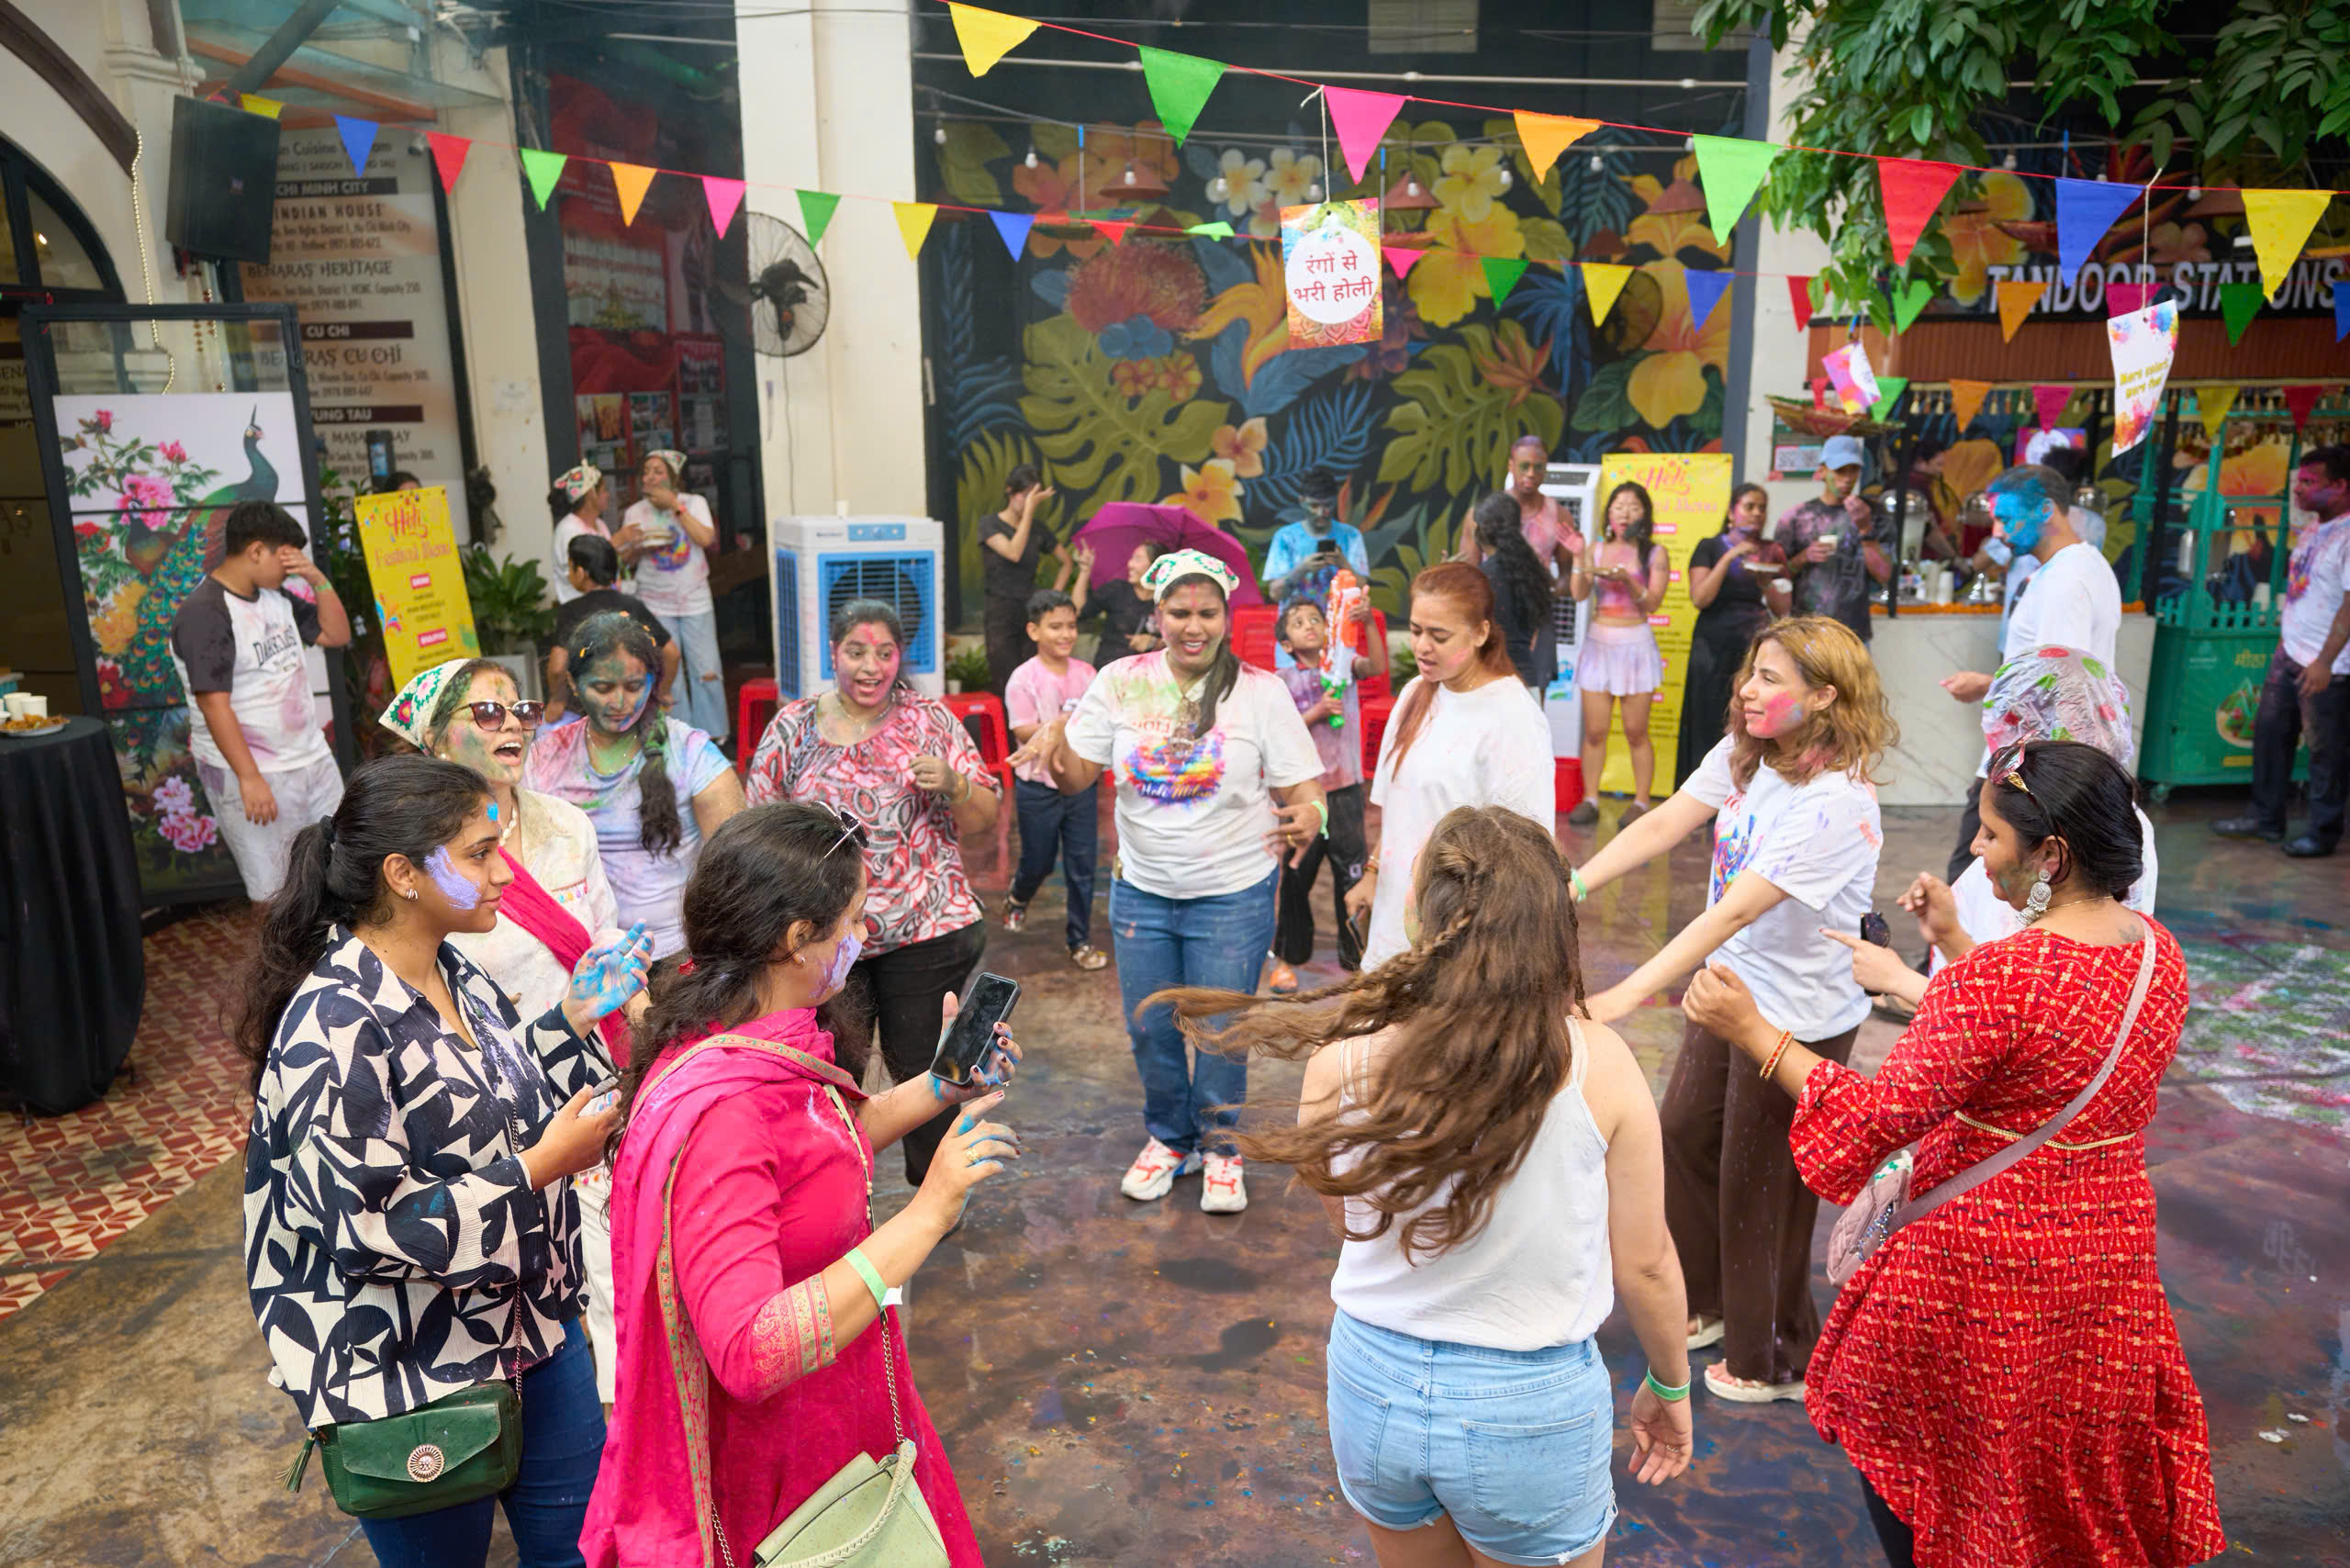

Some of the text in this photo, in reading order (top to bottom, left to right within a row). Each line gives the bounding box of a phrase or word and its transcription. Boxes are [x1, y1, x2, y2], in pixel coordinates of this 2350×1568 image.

[276, 182, 369, 196] CHI MINH CITY
[274, 203, 383, 220] INDIAN HOUSE
[319, 259, 394, 278] HERITAGE
[1305, 250, 1359, 274] रंगों से
[1293, 275, 1374, 302] भरी होली
[2172, 258, 2344, 312] STATONS
[307, 324, 351, 338] CU CHI
[260, 346, 339, 368] BERAS
[342, 347, 367, 365] CU
[346, 408, 373, 421] TAU
[1141, 780, 1169, 799] Holi
